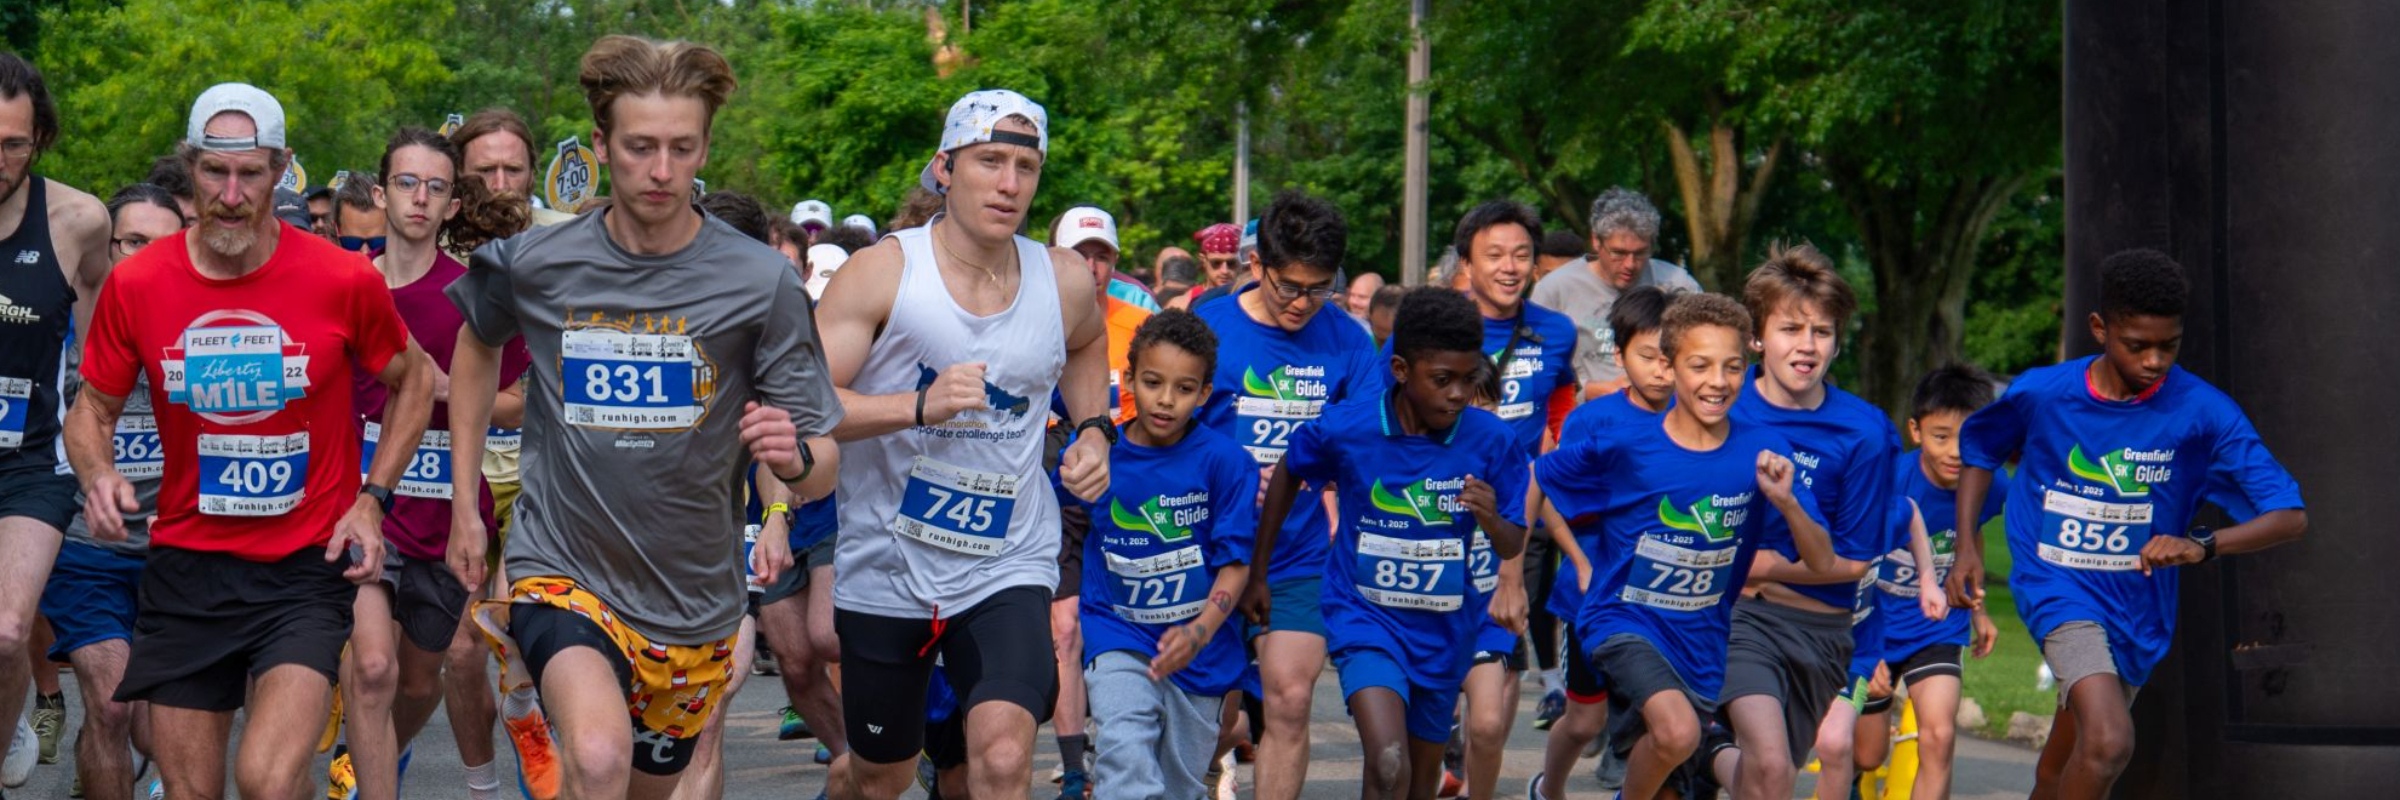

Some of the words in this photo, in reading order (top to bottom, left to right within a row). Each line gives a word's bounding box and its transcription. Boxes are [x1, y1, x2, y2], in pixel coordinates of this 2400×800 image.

[283, 173, 297, 185] 30
[557, 166, 588, 193] 7:00
[191, 336, 228, 346] FLEET
[244, 335, 274, 345] FEET
[168, 370, 183, 381] 20
[201, 359, 262, 381] Liberty
[285, 367, 302, 378] 22
[1285, 364, 1325, 377] Greenfield
[585, 363, 669, 403] 831
[1279, 380, 1290, 391] 5K
[1295, 380, 1327, 396] Glide
[602, 414, 677, 425] runhigh.com
[956, 428, 1004, 443] challenge
[1006, 428, 1027, 440] team
[1253, 419, 1304, 446] 92
[2124, 447, 2175, 462] Greenfield
[118, 464, 164, 475] runhigh.c
[403, 452, 440, 480] 28
[2115, 464, 2130, 477] 5K
[219, 461, 292, 494] 409
[2135, 464, 2172, 482] Glide
[1425, 477, 1465, 490] Greenfie
[2074, 485, 2081, 493] 1,
[2083, 486, 2104, 496] 2025
[233, 499, 295, 511] runhigh.com
[1159, 491, 1209, 507] Greenfield
[1417, 495, 1431, 507] 5K
[923, 486, 996, 532] 745
[1154, 513, 1168, 524] 5K
[1174, 506, 1209, 527] Glide
[1704, 511, 1717, 524] 5K
[1378, 519, 1387, 528] 1,
[1388, 520, 1409, 529] 2025
[928, 531, 991, 551] runhigh.com
[1103, 534, 1119, 545] June
[1120, 537, 1127, 546] 1,
[1129, 537, 1149, 546] 2025
[1663, 535, 1671, 543] 1,
[1672, 536, 1694, 544] 2025
[2059, 518, 2130, 553] 856
[2069, 557, 2132, 567] runhigh.com
[1375, 559, 1445, 592] 857
[1648, 563, 1714, 594] 728
[1122, 573, 1187, 606] 727
[1387, 596, 1449, 607] runhigh.com
[1654, 598, 1710, 608] runhigh.com
[1140, 606, 1199, 620] runhigh.com
